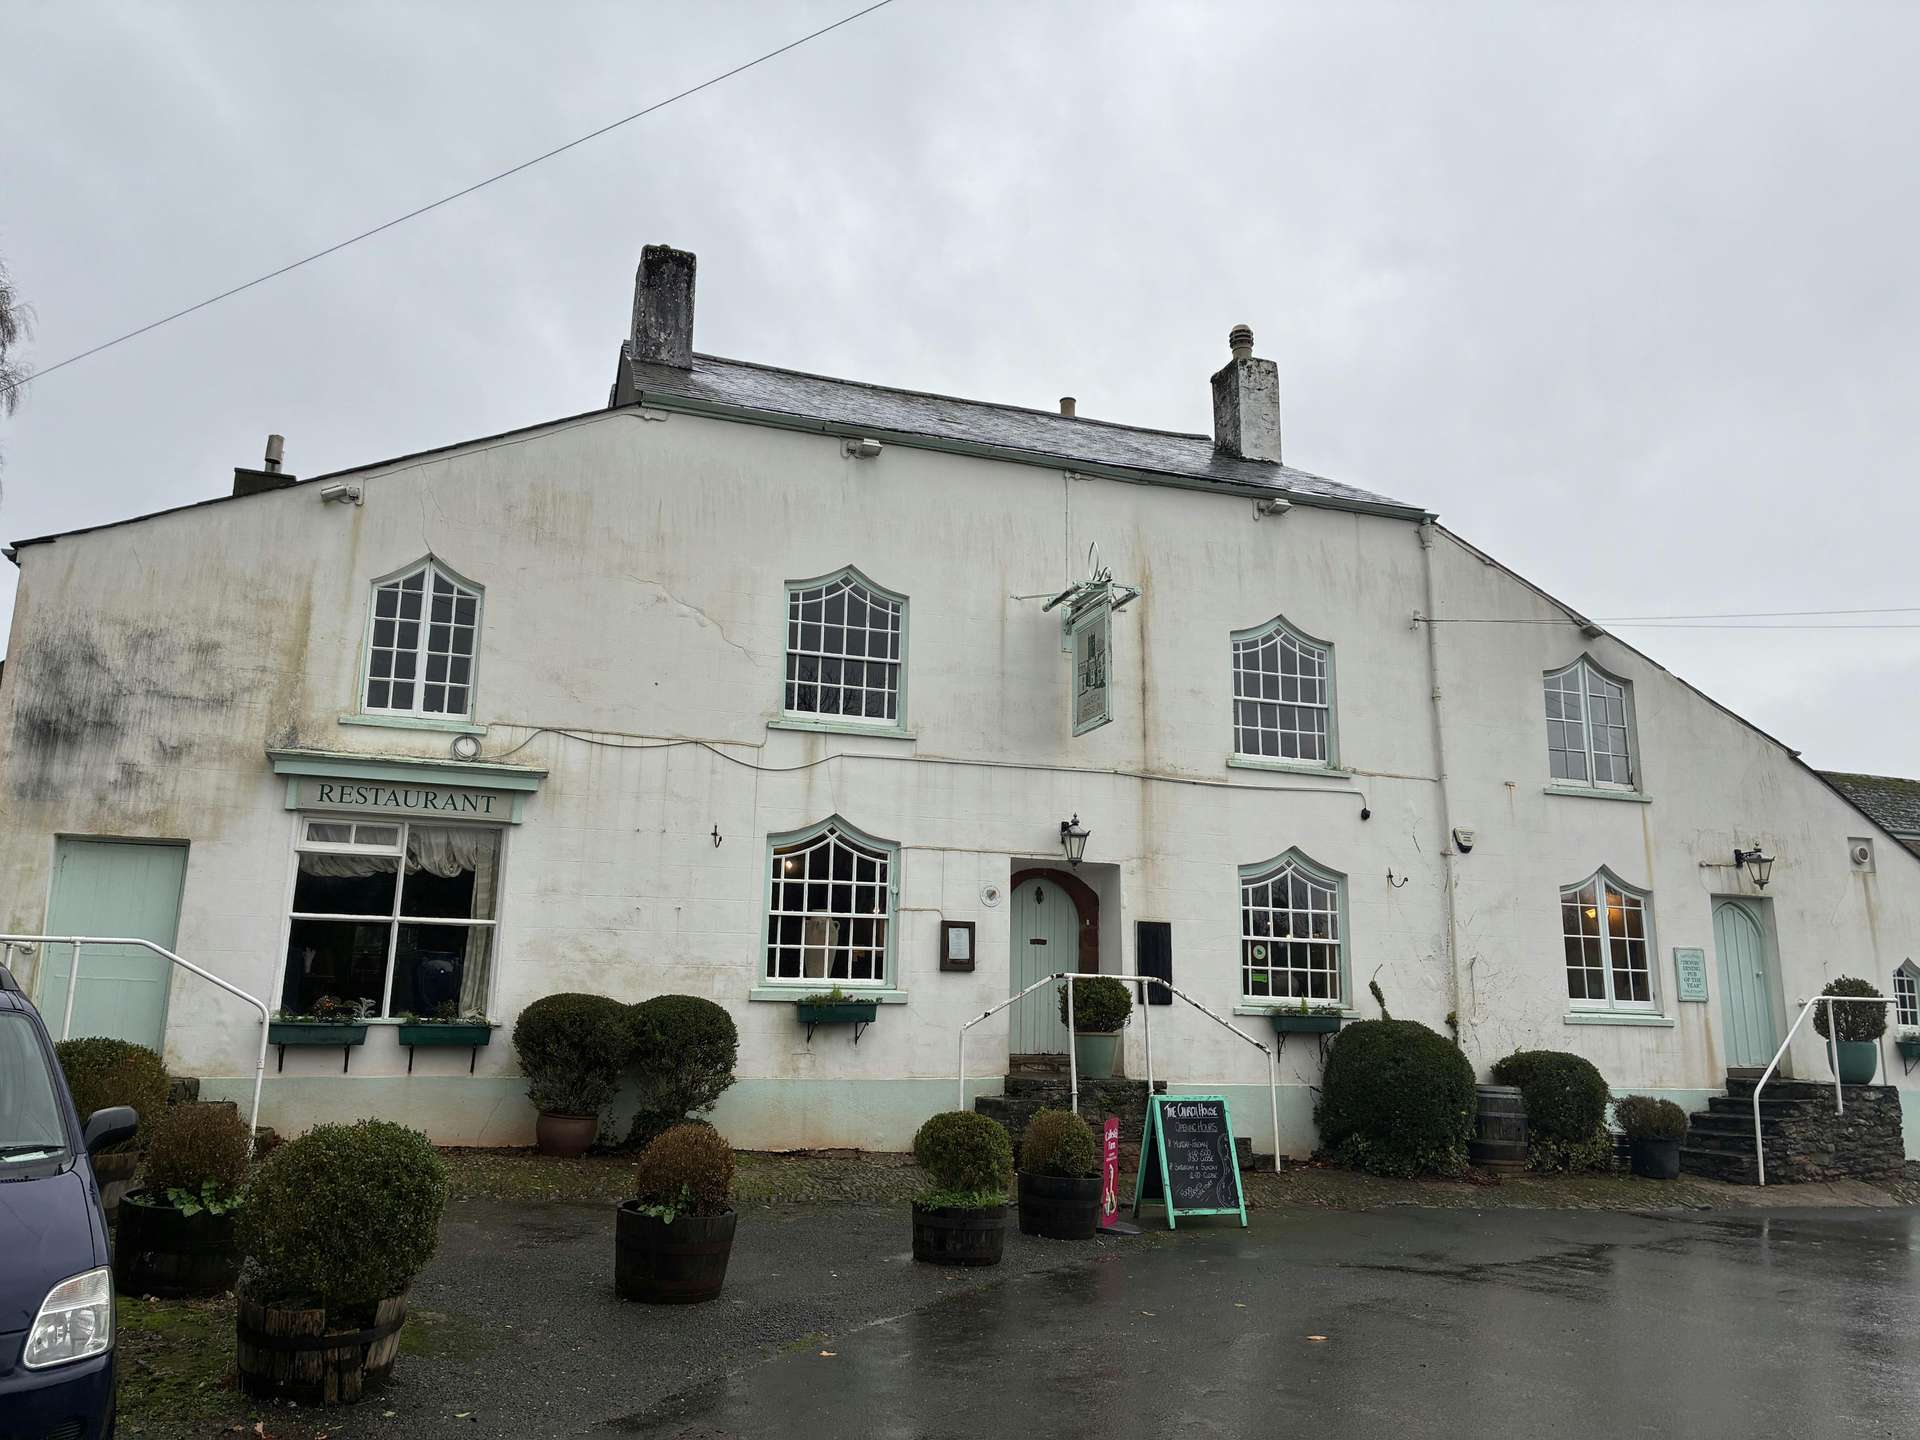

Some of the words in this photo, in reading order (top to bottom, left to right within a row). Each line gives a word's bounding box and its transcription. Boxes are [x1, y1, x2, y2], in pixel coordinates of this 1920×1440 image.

[318, 784, 497, 813] RESTAURANT
[1164, 1102, 1177, 1118] THE
[1198, 1103, 1218, 1116] HOUSE
[1197, 1121, 1218, 1131] HOURS
